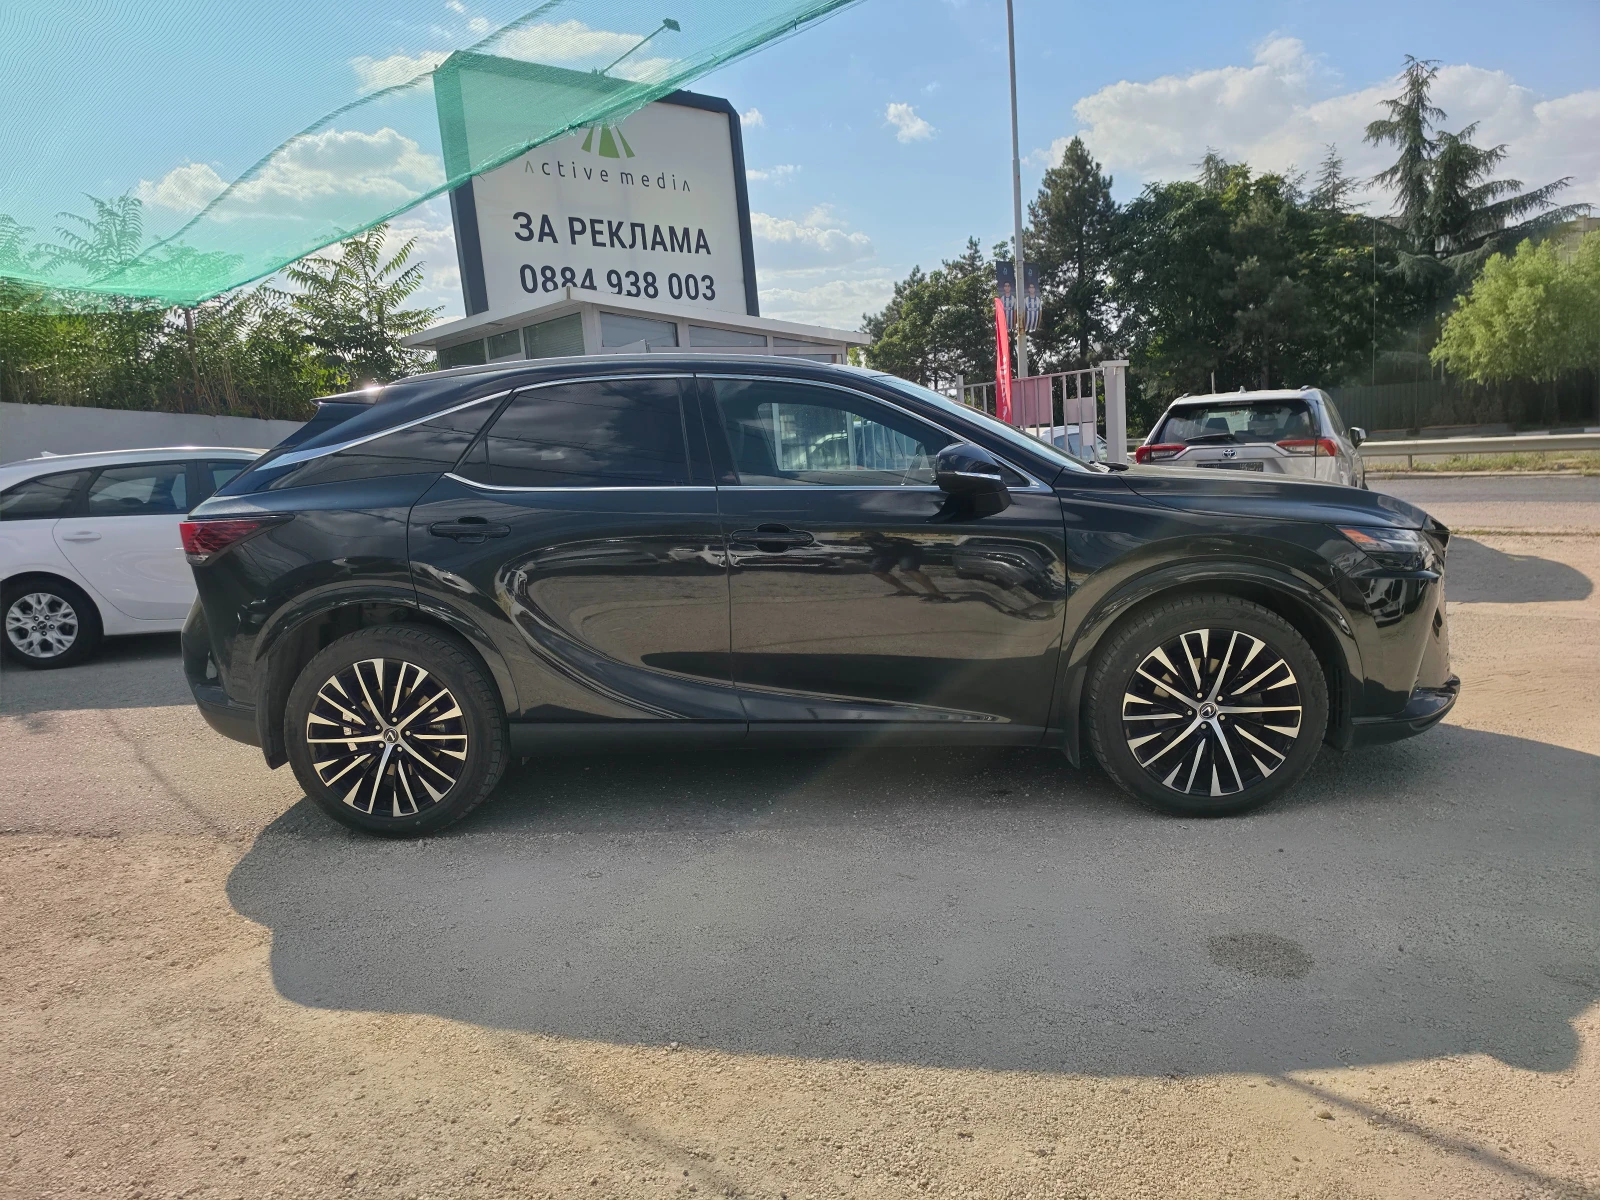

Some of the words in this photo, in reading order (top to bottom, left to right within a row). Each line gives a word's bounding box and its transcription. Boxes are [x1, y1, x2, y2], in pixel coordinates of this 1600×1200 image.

[512, 211, 559, 243] ЗА
[568, 216, 711, 255] РЕКЛАМА
[519, 263, 598, 294] 0884
[606, 269, 659, 299] 938
[668, 272, 716, 301] 003
